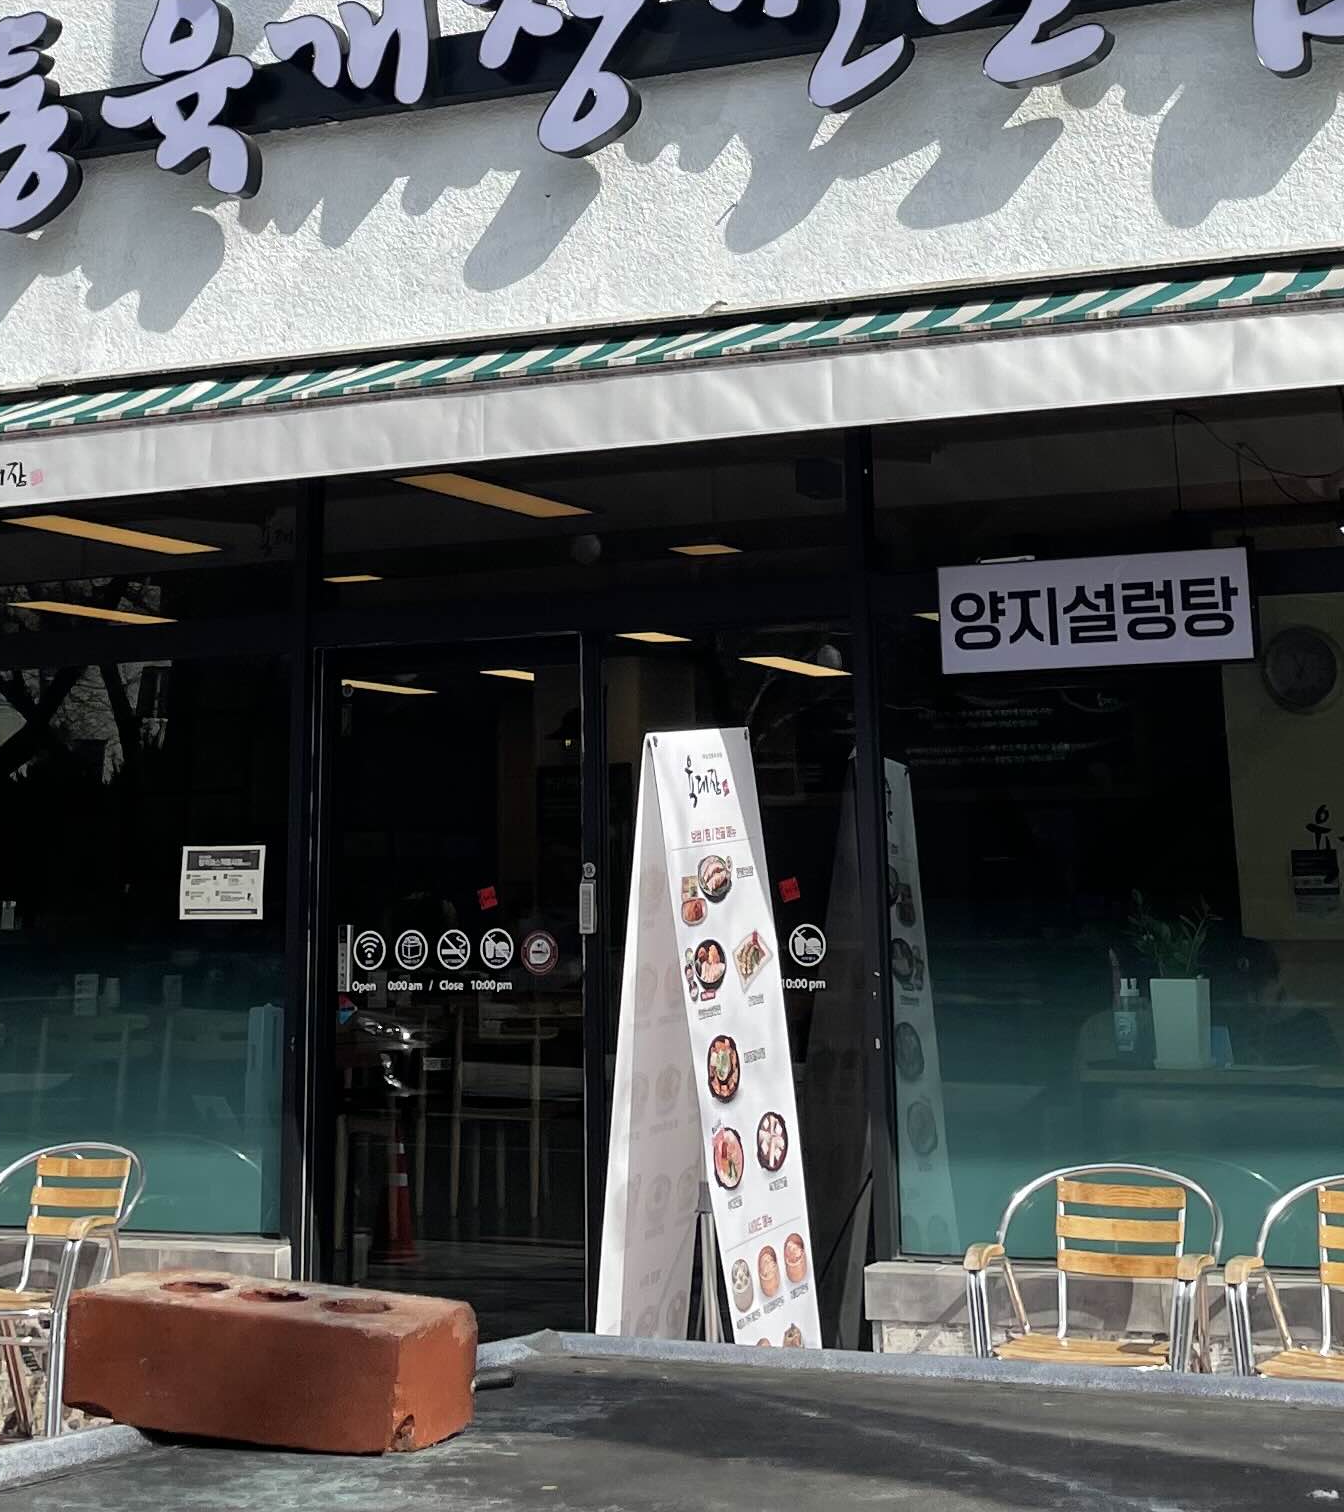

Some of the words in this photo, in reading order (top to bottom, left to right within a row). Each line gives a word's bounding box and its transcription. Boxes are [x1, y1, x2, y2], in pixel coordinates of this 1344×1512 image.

[950, 575, 1239, 650] 양지설렁탕
[352, 980, 376, 993] Open
[439, 979, 464, 991] Close
